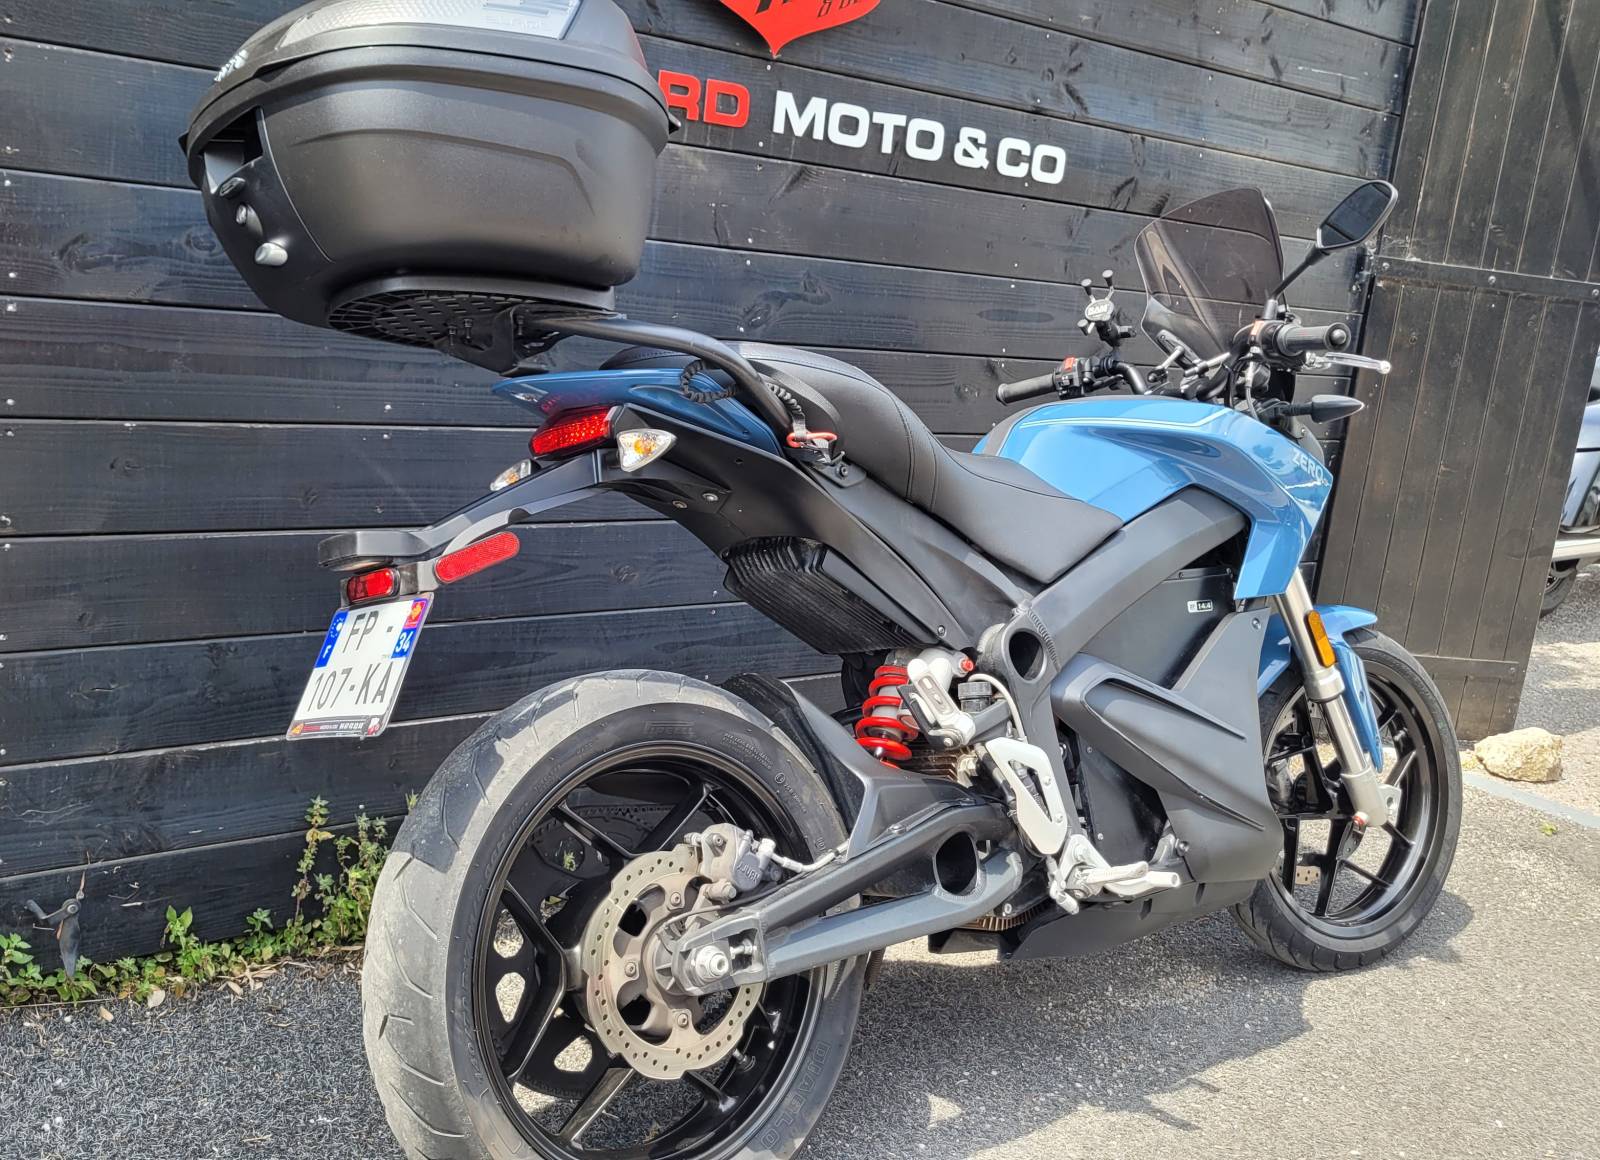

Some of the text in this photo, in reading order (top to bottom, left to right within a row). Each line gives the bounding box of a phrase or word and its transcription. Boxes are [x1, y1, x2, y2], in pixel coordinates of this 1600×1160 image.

[1292, 448, 1324, 482] ZERO
[322, 644, 332, 659] F
[395, 631, 414, 653] 34
[307, 662, 394, 713] 107-KA
